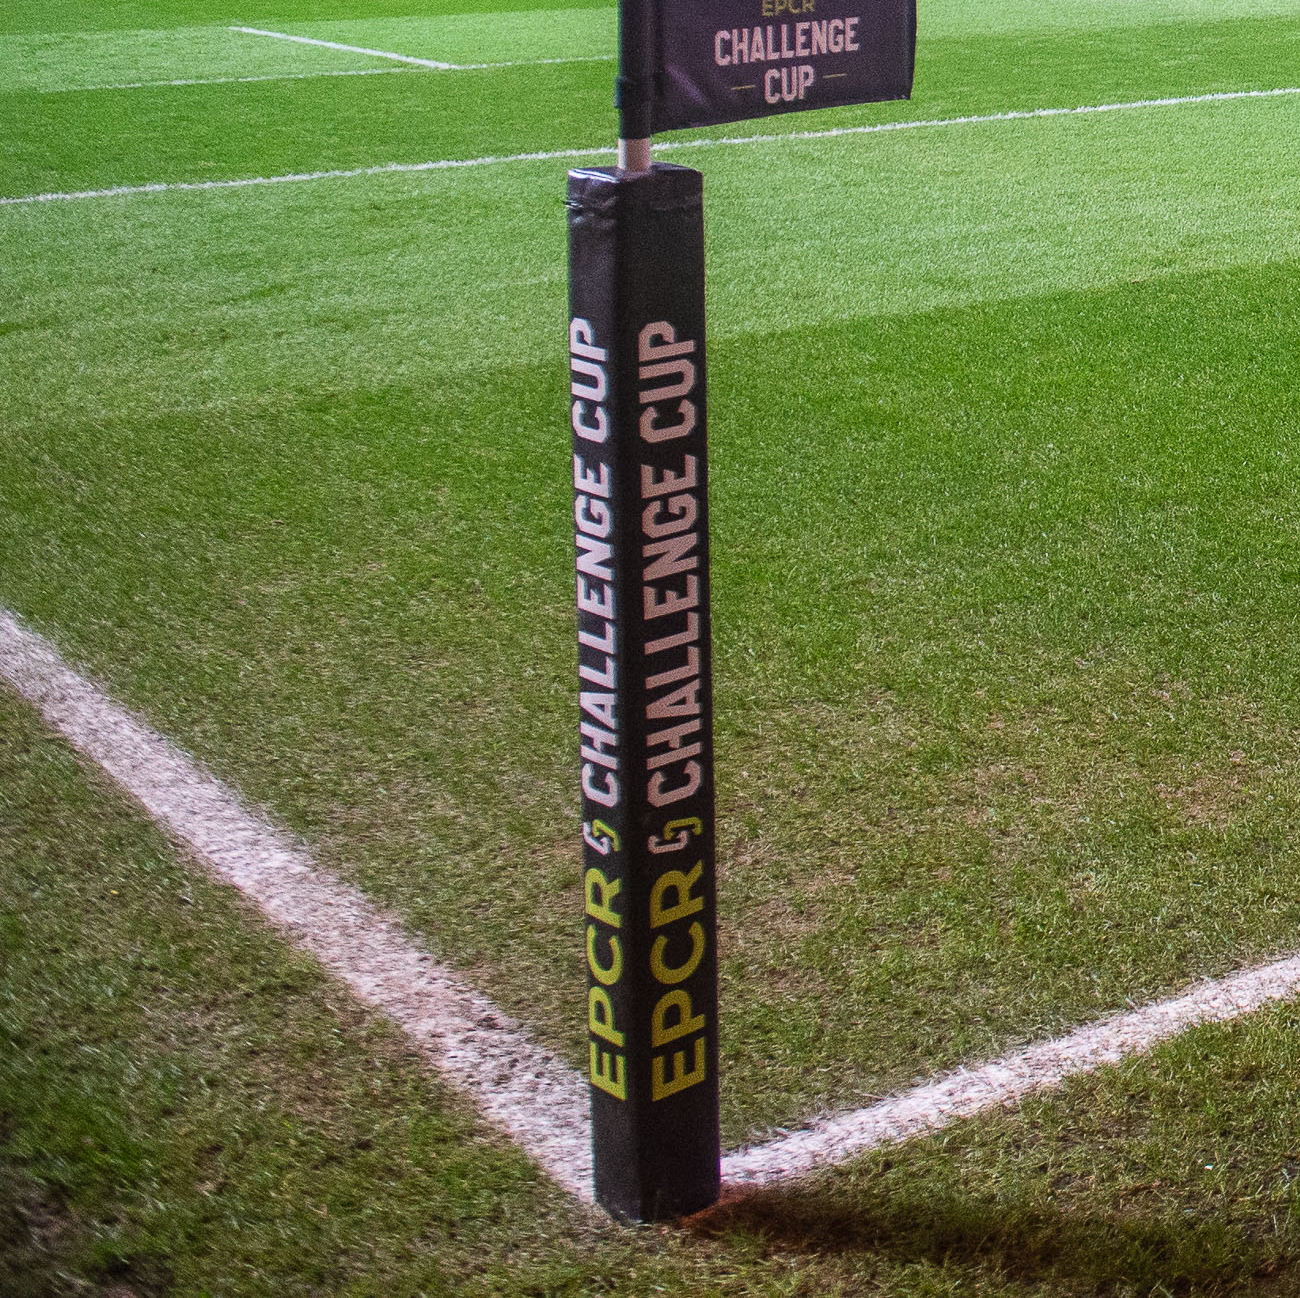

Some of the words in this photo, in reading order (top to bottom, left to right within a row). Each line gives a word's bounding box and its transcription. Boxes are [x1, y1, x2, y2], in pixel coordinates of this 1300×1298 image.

[714, 17, 860, 66] CHALLENGE
[764, 65, 815, 104] CUP
[569, 317, 612, 441] CUP
[638, 320, 697, 446] CUP
[573, 452, 623, 809] CHALLENGE
[642, 454, 703, 810] CHALLENGE
[586, 867, 628, 1102] EPCR
[652, 859, 707, 1102] EPCR
